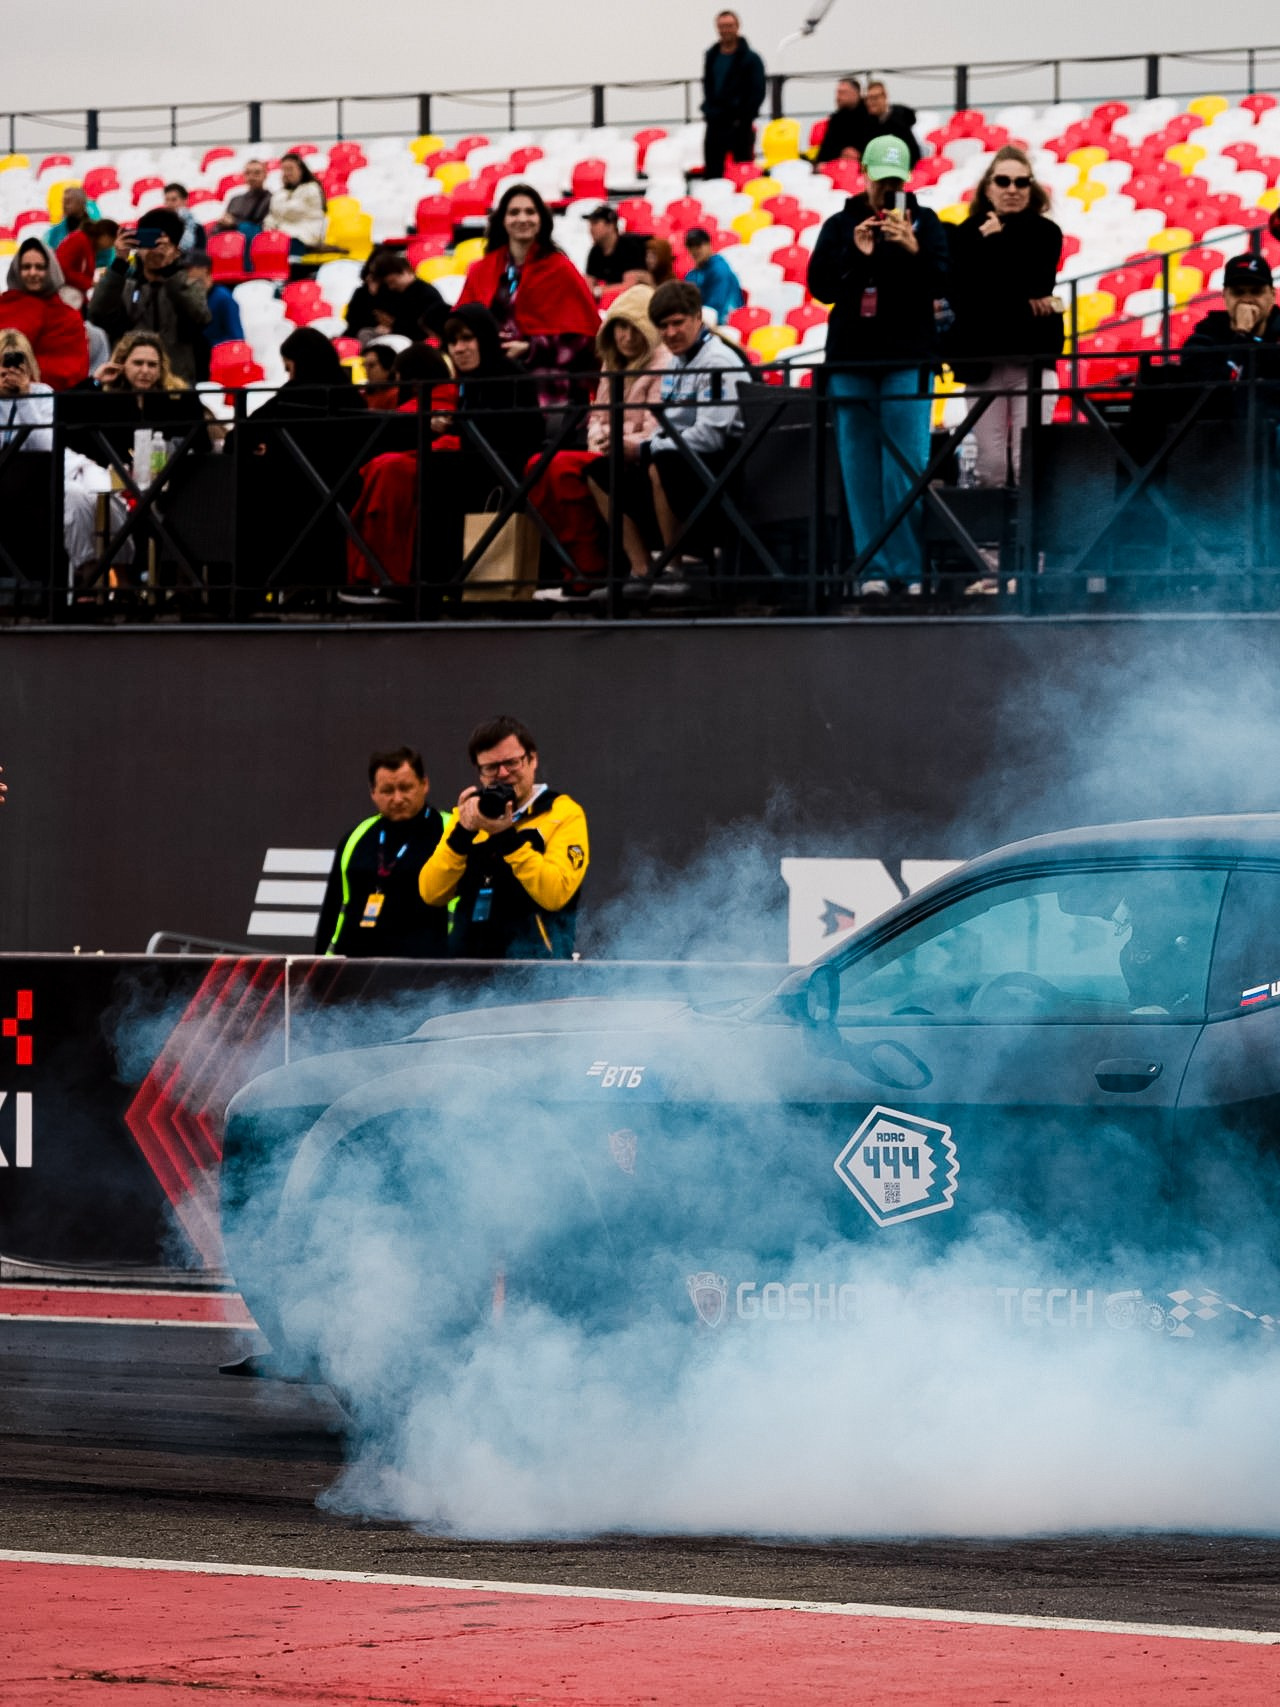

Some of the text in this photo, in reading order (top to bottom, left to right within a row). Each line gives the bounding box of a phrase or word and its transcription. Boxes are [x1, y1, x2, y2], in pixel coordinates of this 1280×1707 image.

[601, 1066, 646, 1088] ВТБ
[876, 1132, 906, 1143] RDRC
[863, 1146, 920, 1179] 444
